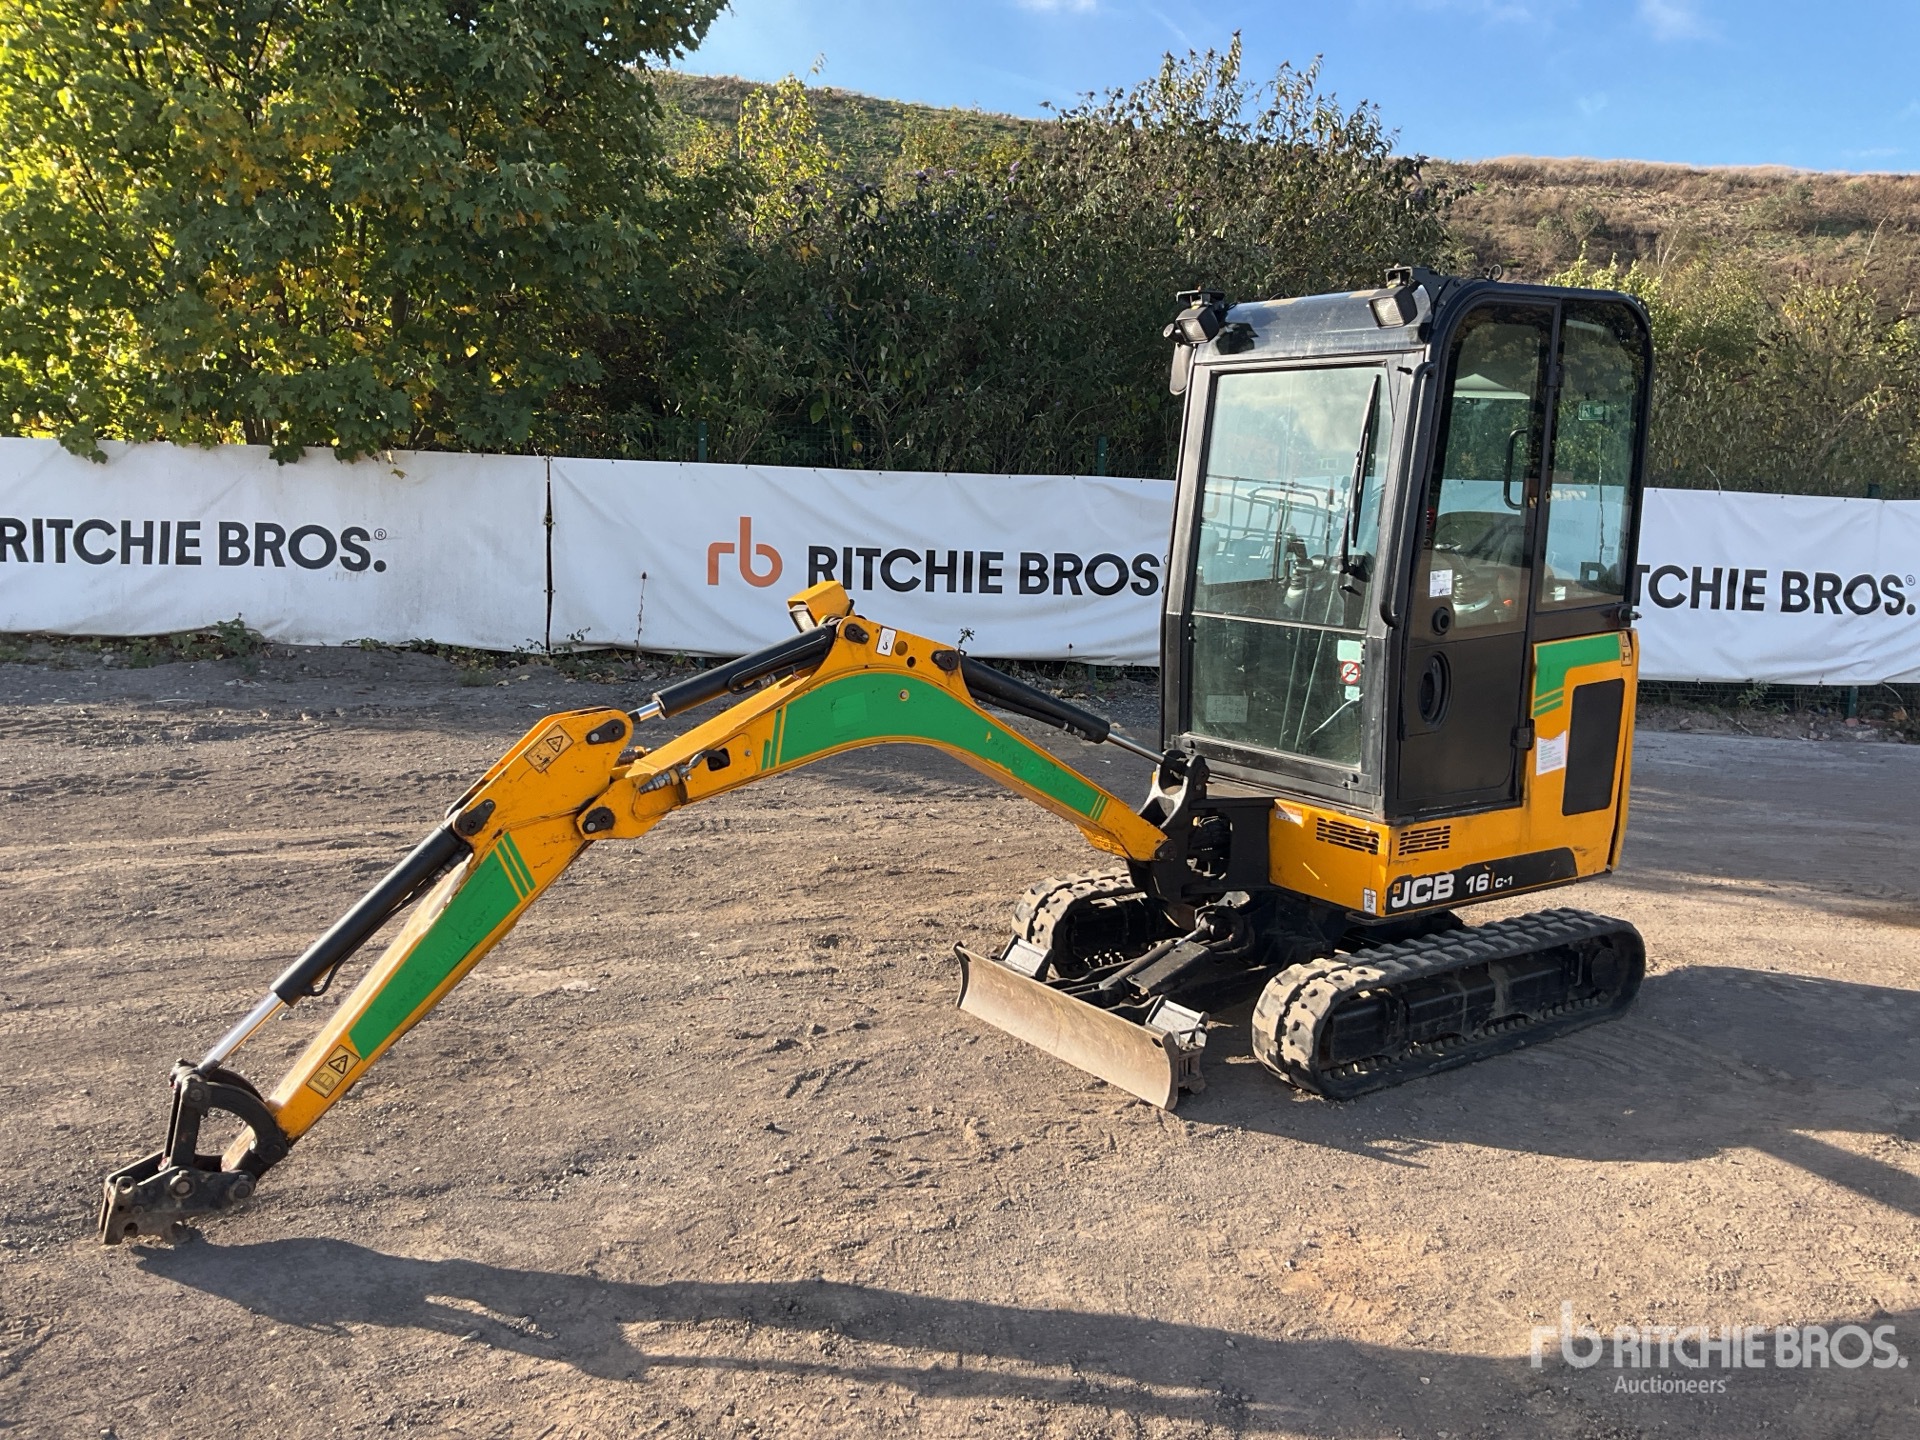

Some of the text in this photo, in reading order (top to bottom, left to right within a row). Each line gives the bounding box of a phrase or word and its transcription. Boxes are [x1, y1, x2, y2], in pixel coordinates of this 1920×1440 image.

[0, 517, 202, 566] RITCHIE
[808, 545, 1004, 594] RITCHIE
[1391, 873, 1455, 908] JCB
[1466, 873, 1490, 893] 16
